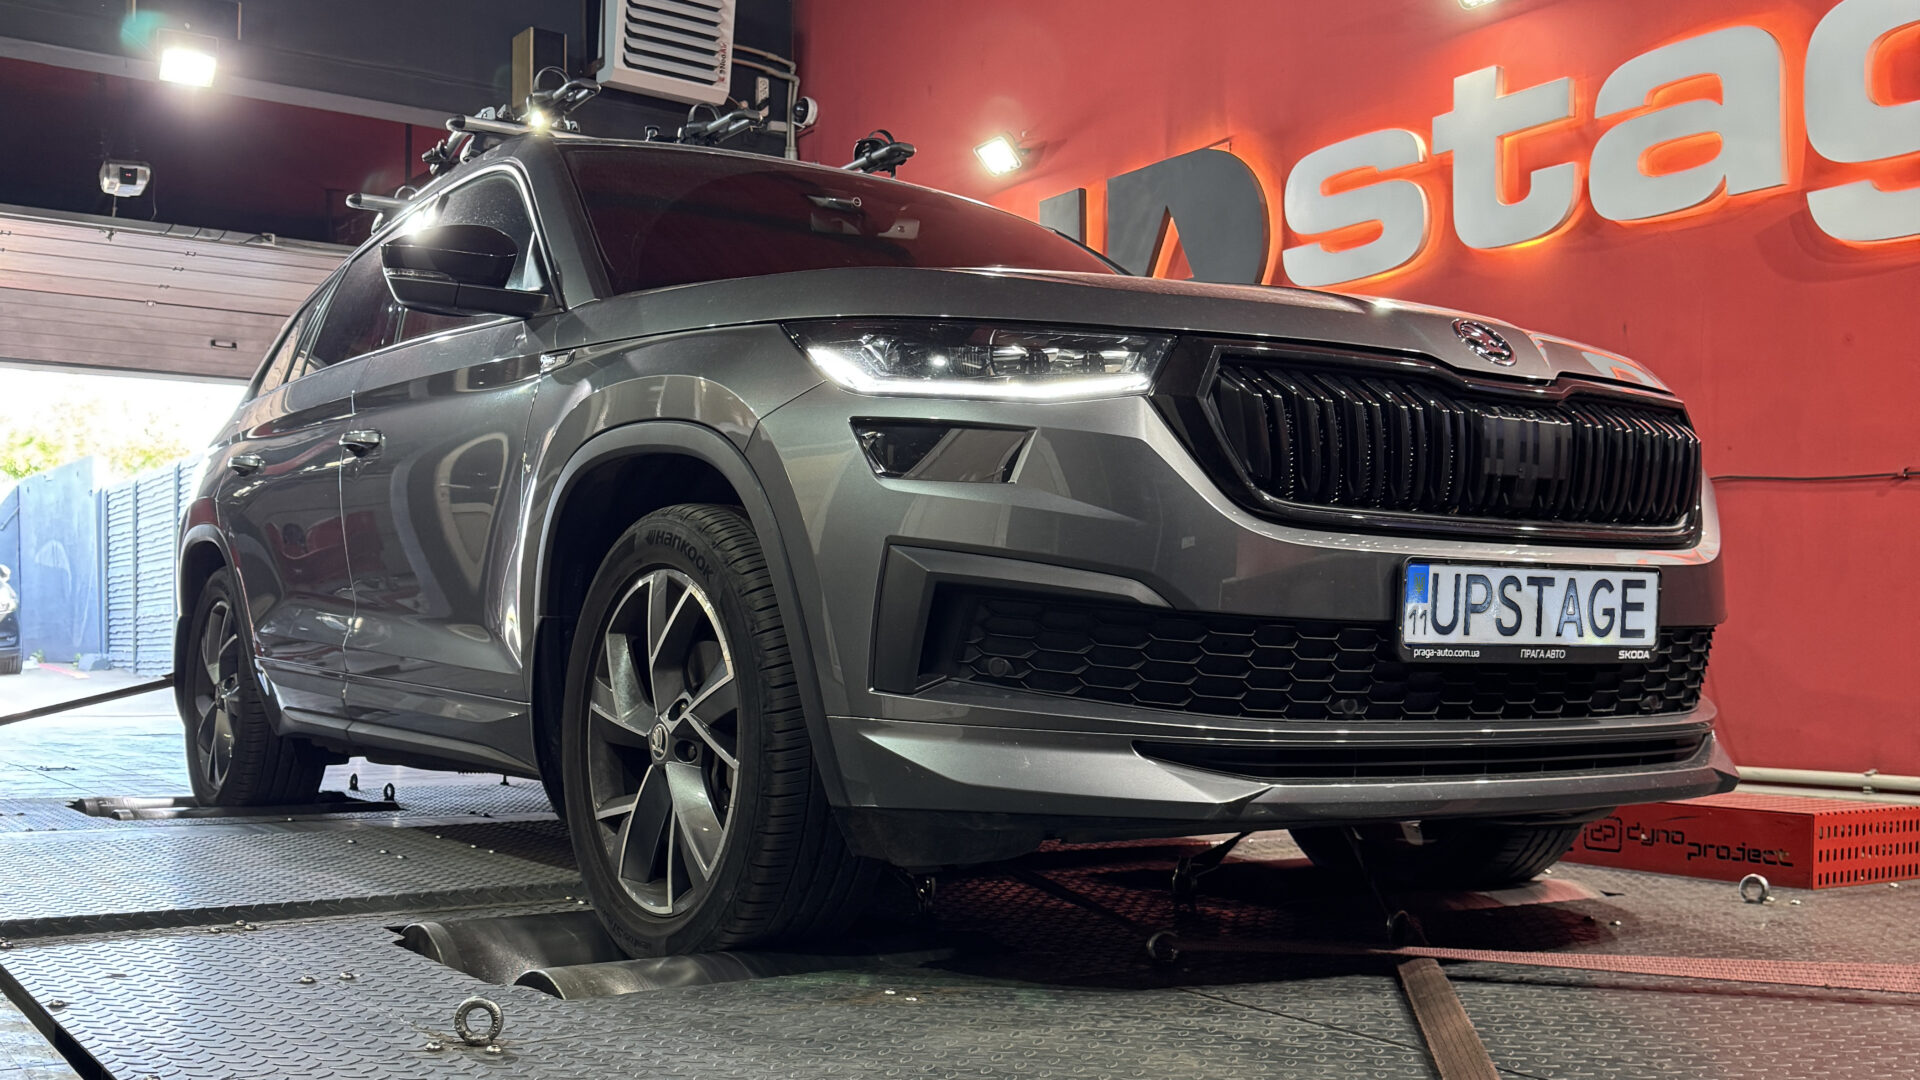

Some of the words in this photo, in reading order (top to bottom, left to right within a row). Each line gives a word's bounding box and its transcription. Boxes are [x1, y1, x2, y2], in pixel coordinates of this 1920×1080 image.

[1431, 573, 1646, 638] UPSTAGE
[1409, 609, 1427, 635] 11
[1413, 648, 1480, 659] praga-auto.com.ua
[1520, 649, 1545, 659] ПРАГА
[1545, 649, 1566, 659] АВТО
[1618, 650, 1650, 659] SKODA
[1627, 822, 1684, 846] dyno
[1687, 842, 1794, 867] project
